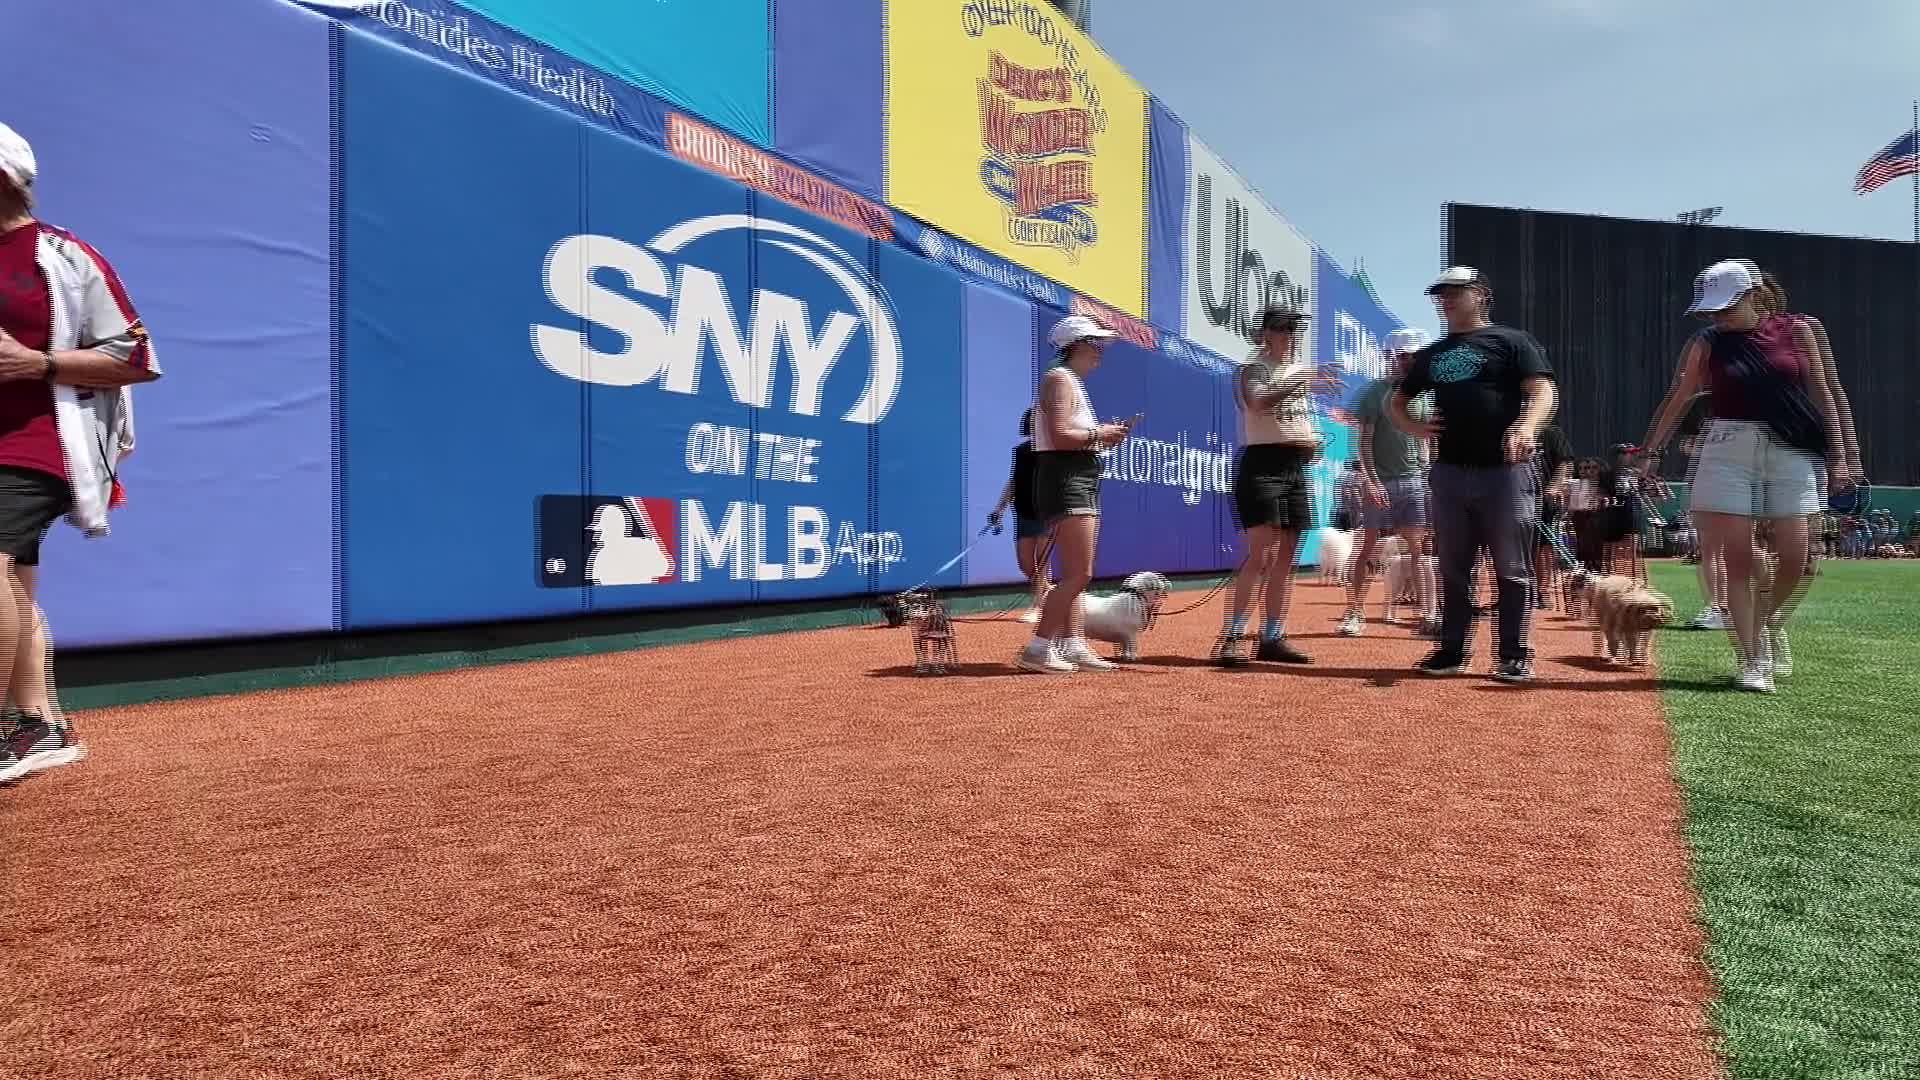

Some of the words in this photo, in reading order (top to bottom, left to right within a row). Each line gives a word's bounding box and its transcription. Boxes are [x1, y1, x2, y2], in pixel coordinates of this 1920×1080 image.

[511, 44, 616, 118] Health
[961, 0, 1017, 38] OVER
[1018, 2, 1056, 47] 100
[1052, 27, 1109, 134] YEARS
[988, 48, 1073, 103] DENO'S
[976, 77, 1096, 156] WONDER
[1009, 159, 1098, 216] WHEEL
[1008, 217, 1044, 243] CONEY
[1041, 221, 1079, 251] ISLAND
[530, 234, 862, 417] SNY
[685, 422, 750, 477] ON
[753, 432, 822, 483] THE
[1096, 431, 1233, 504] ationalgrid
[680, 499, 832, 583] MLB
[832, 520, 903, 577] App
